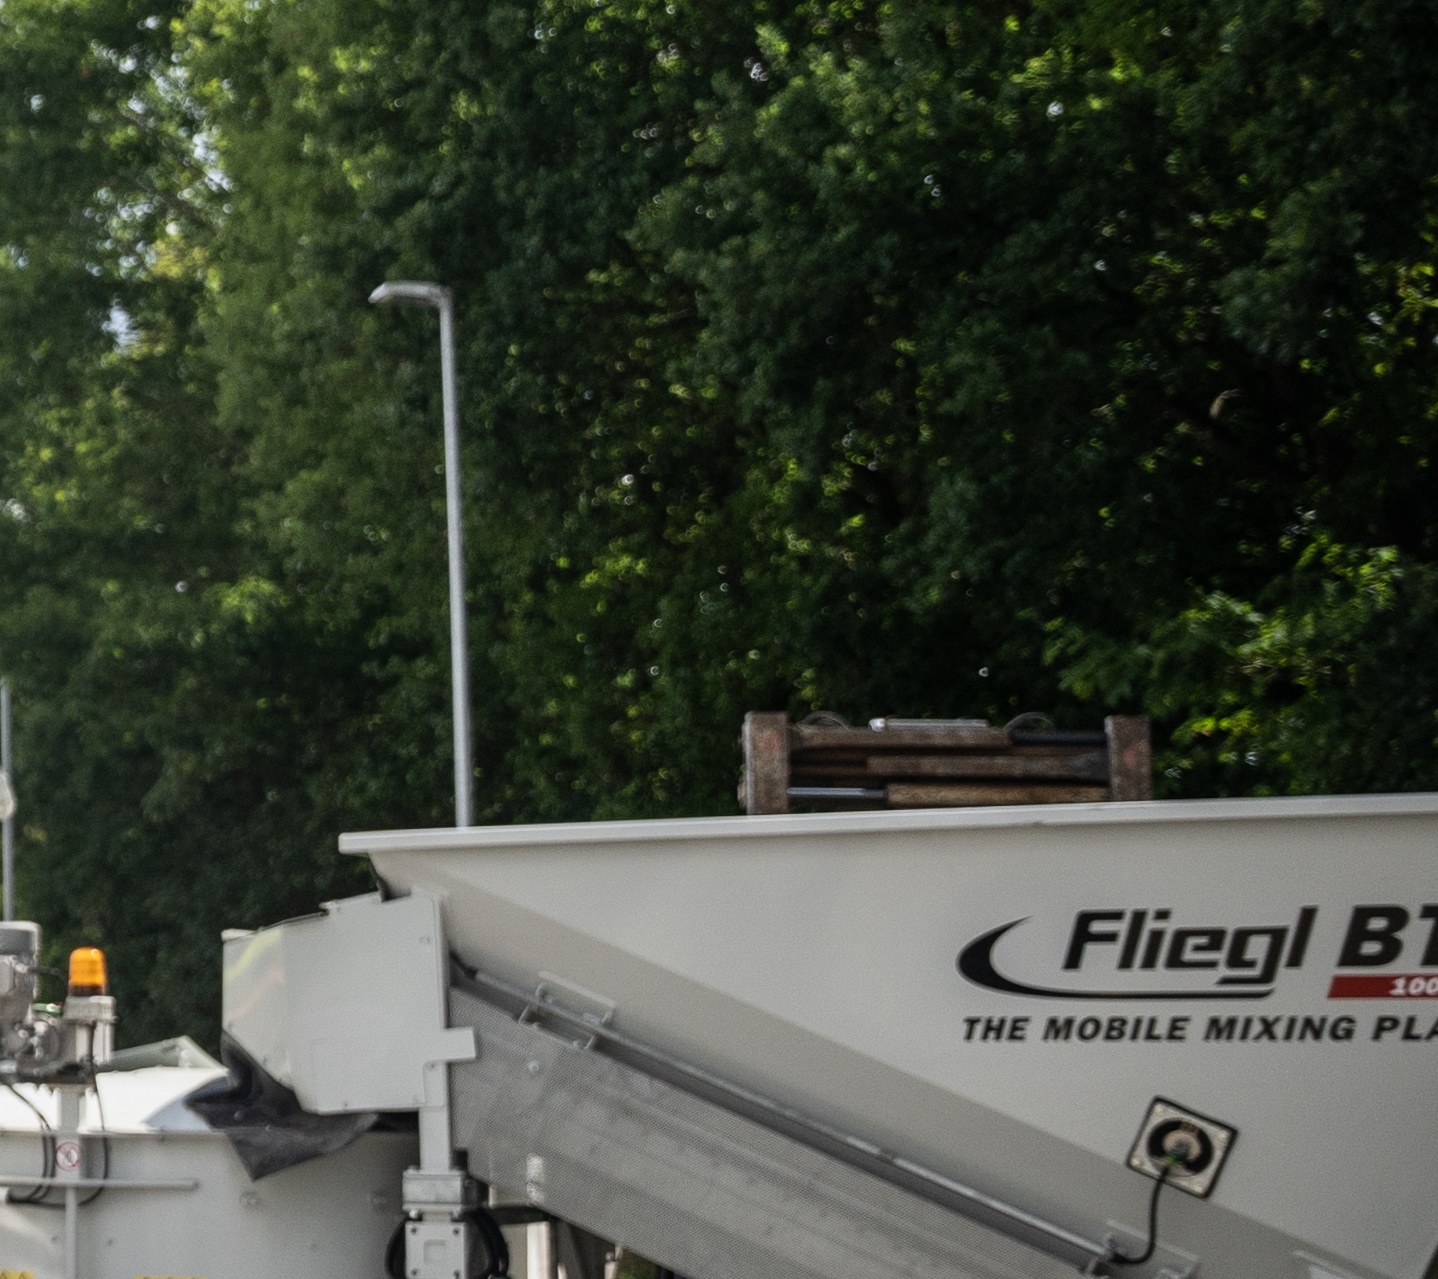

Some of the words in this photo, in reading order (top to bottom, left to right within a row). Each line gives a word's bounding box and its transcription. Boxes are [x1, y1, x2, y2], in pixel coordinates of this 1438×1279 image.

[1061, 905, 1319, 987] Fliegl
[963, 1015, 1031, 1042] THE
[1042, 1015, 1192, 1043] MOBILE
[1203, 1014, 1358, 1043] MIXING
